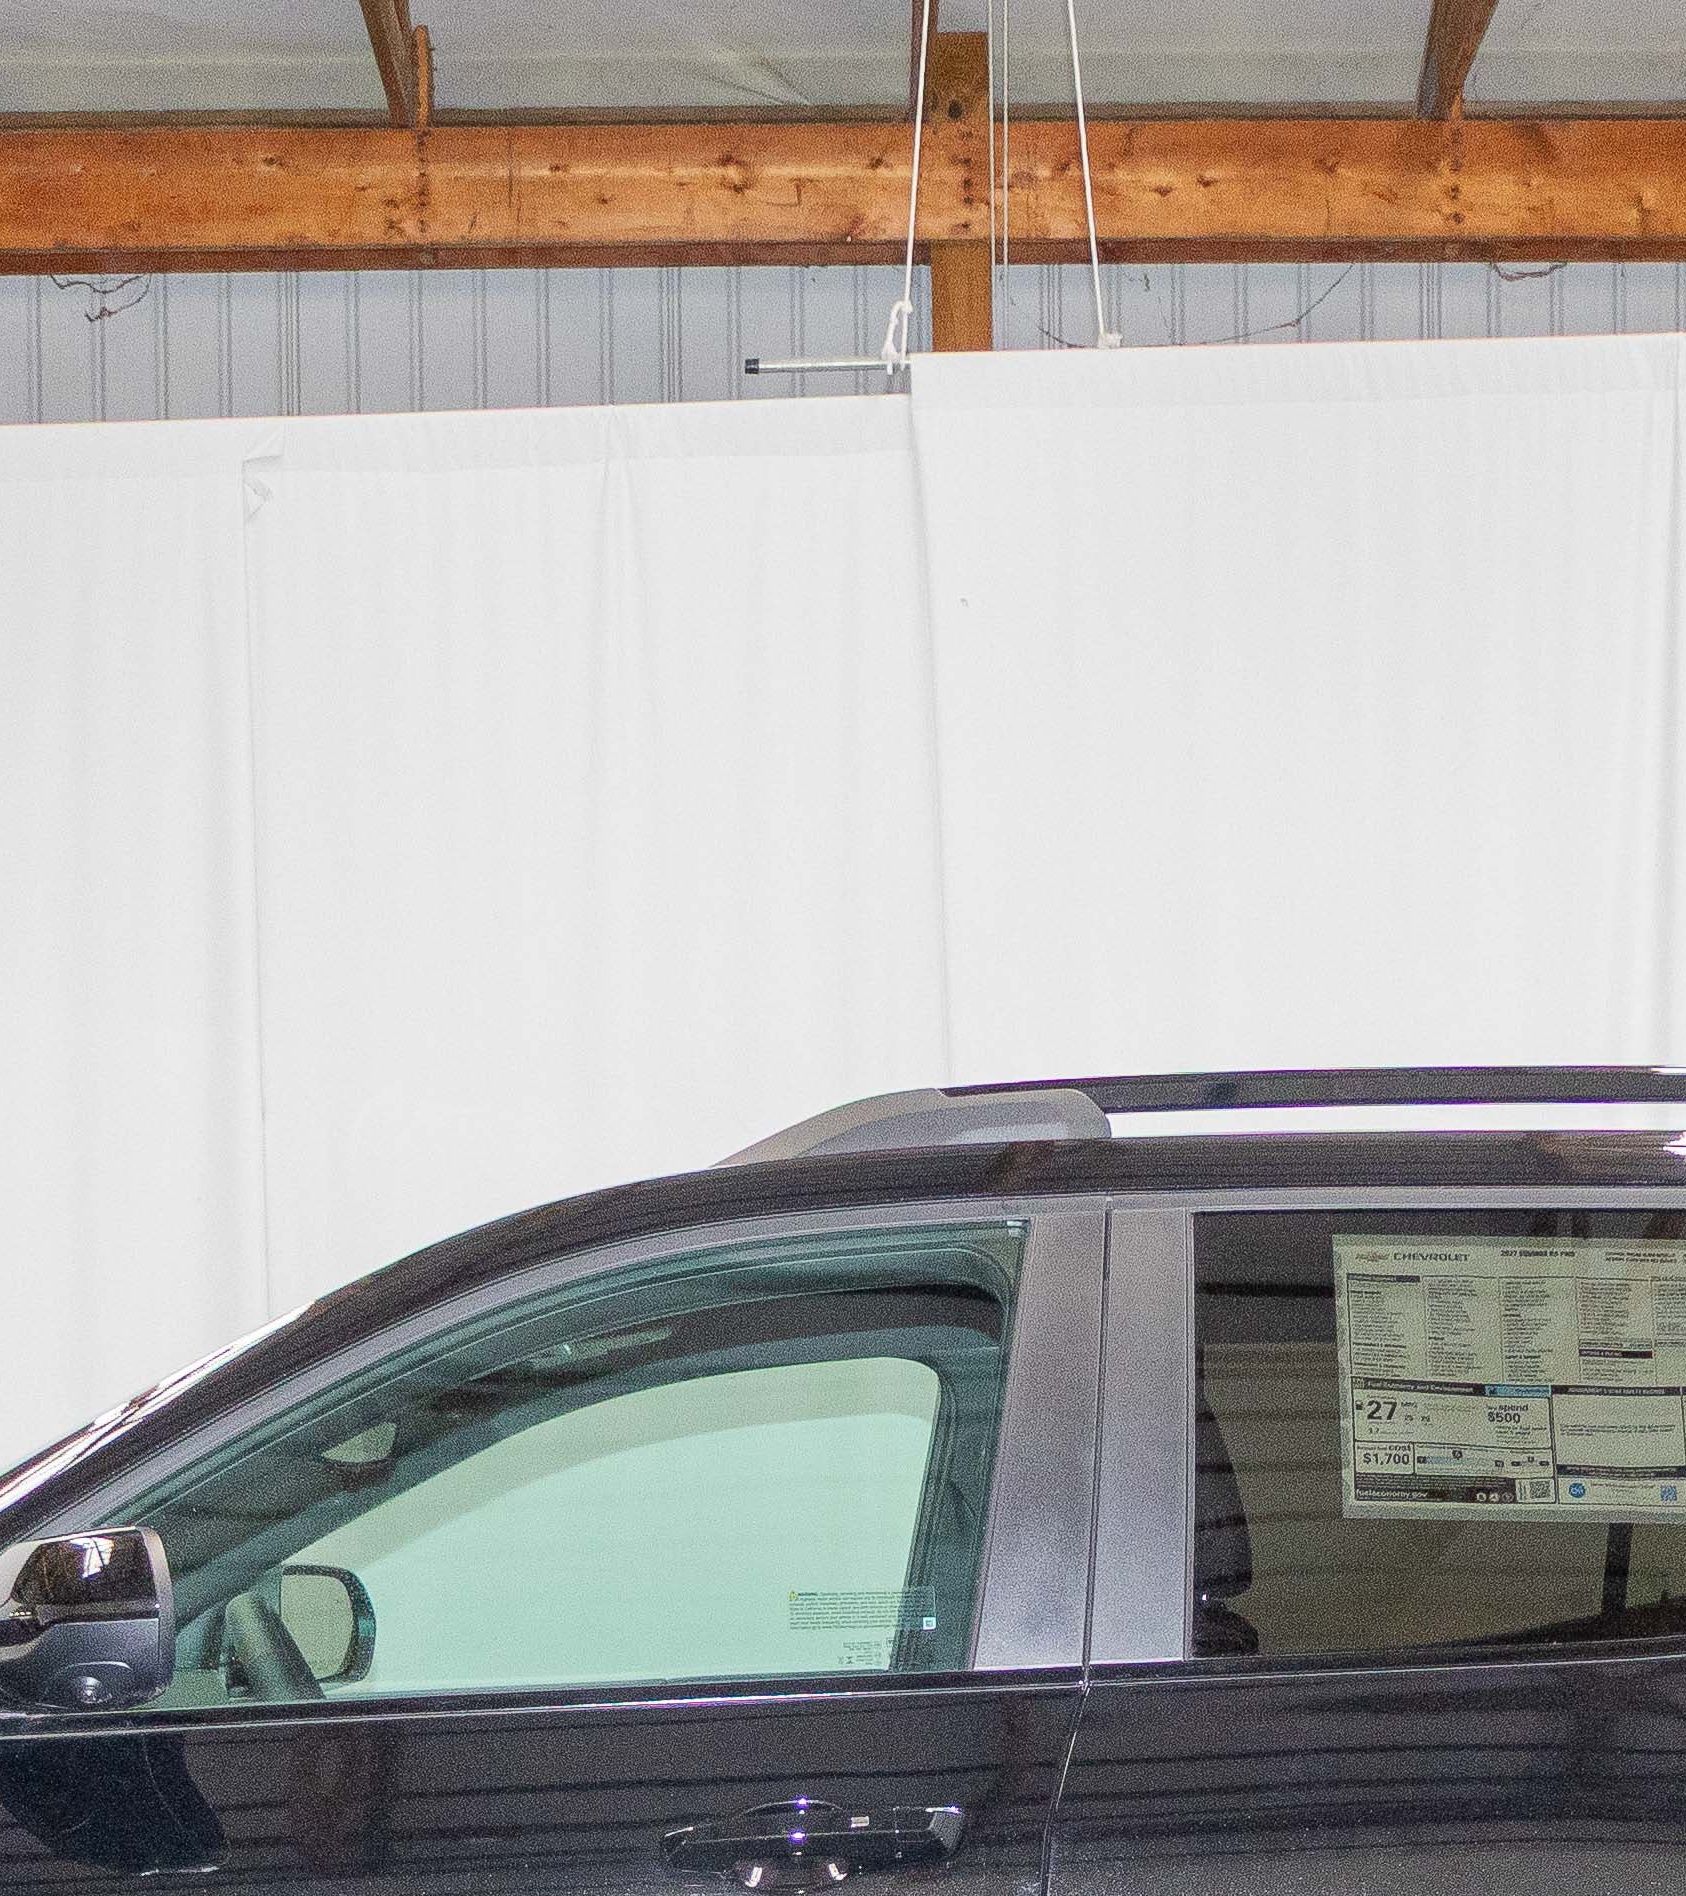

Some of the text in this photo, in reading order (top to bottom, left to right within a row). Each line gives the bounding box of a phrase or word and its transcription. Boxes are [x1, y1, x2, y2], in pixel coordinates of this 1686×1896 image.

[1393, 1252, 1470, 1262] CHEVROLET
[1367, 1400, 1397, 1420] 27
[1499, 1404, 1529, 1412] spend
[1488, 1412, 1521, 1423] $500
[1363, 1452, 1410, 1466] $1,700
